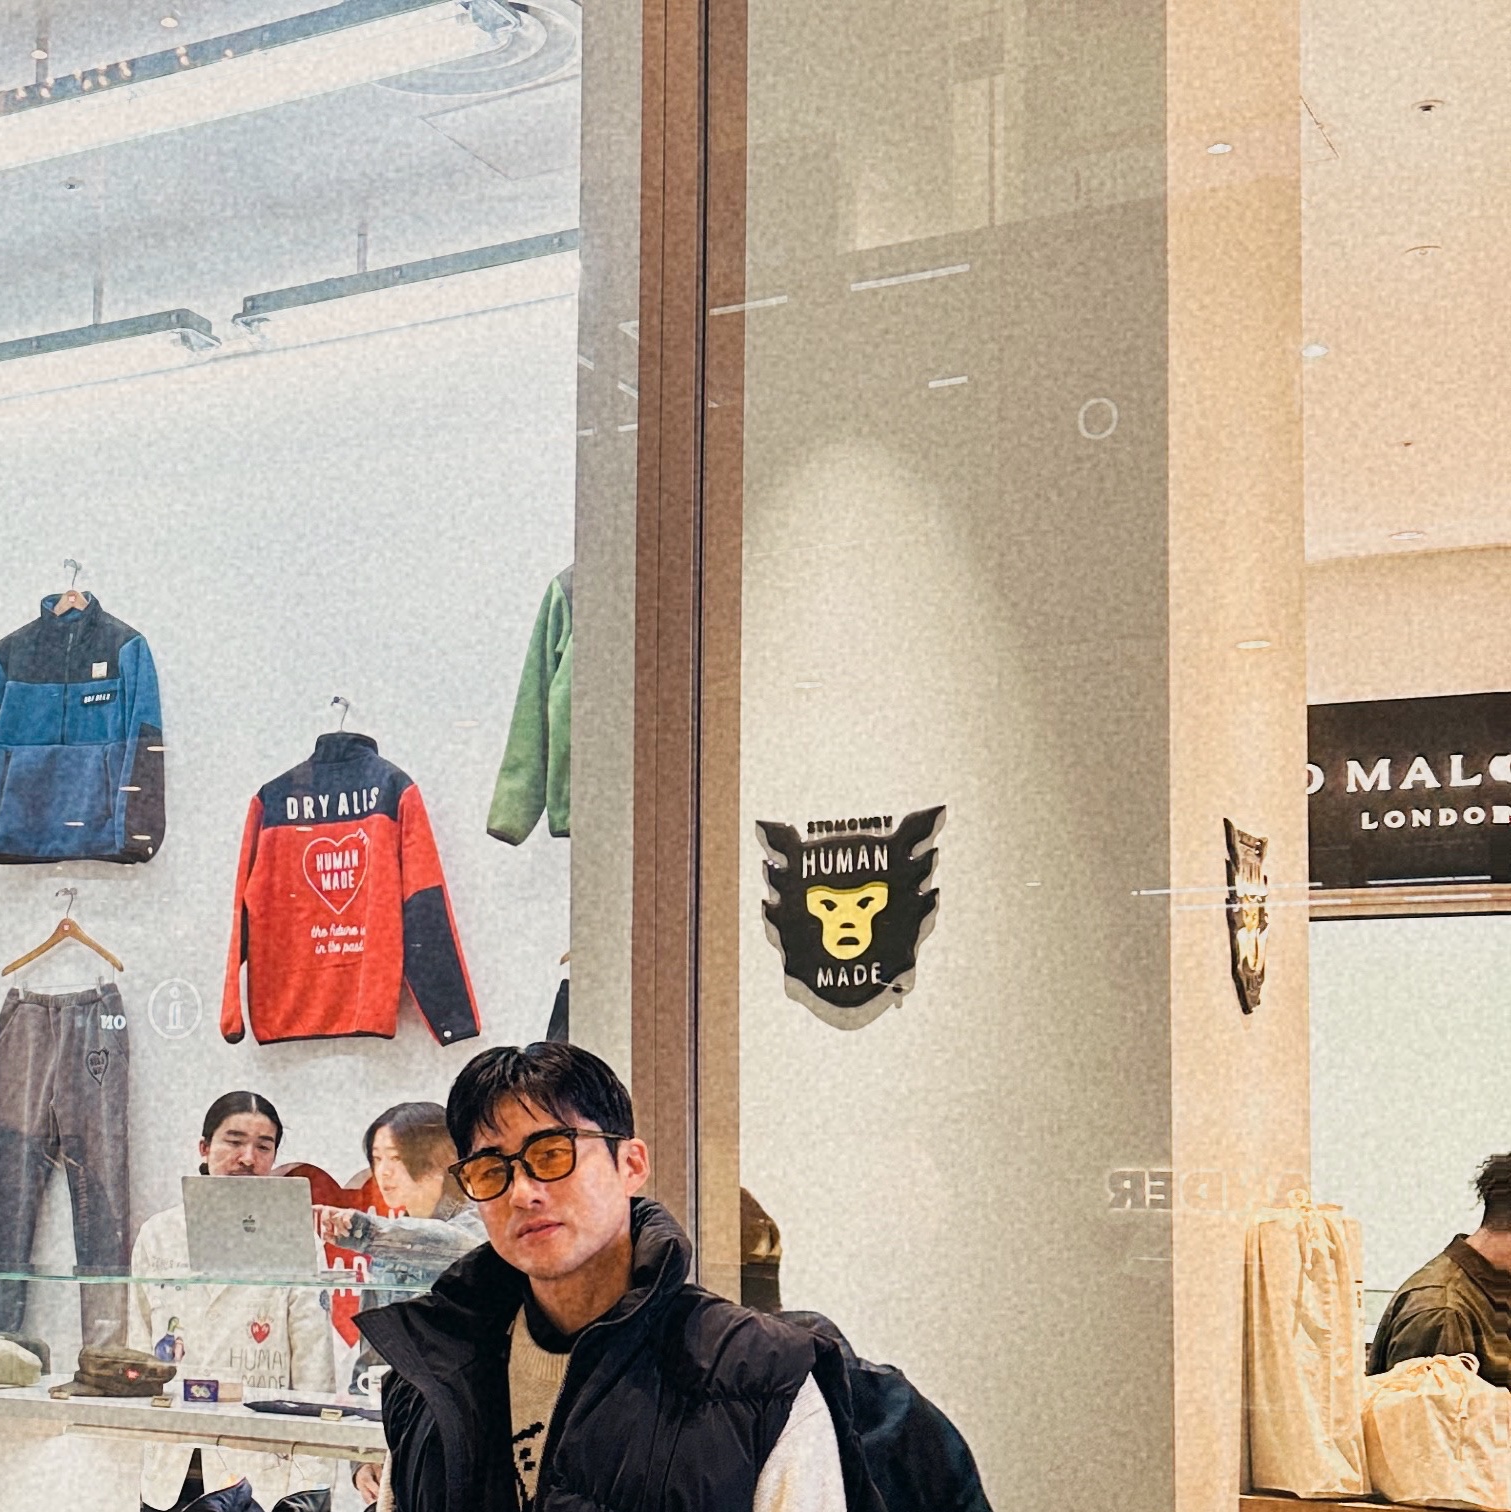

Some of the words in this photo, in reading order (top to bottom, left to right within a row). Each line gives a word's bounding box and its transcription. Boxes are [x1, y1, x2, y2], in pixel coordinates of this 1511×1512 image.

[286, 793, 330, 820] DRY
[315, 849, 359, 873] HUMAN
[802, 844, 889, 879] HUMAN
[321, 870, 355, 892] MADE
[816, 961, 882, 989] MADE
